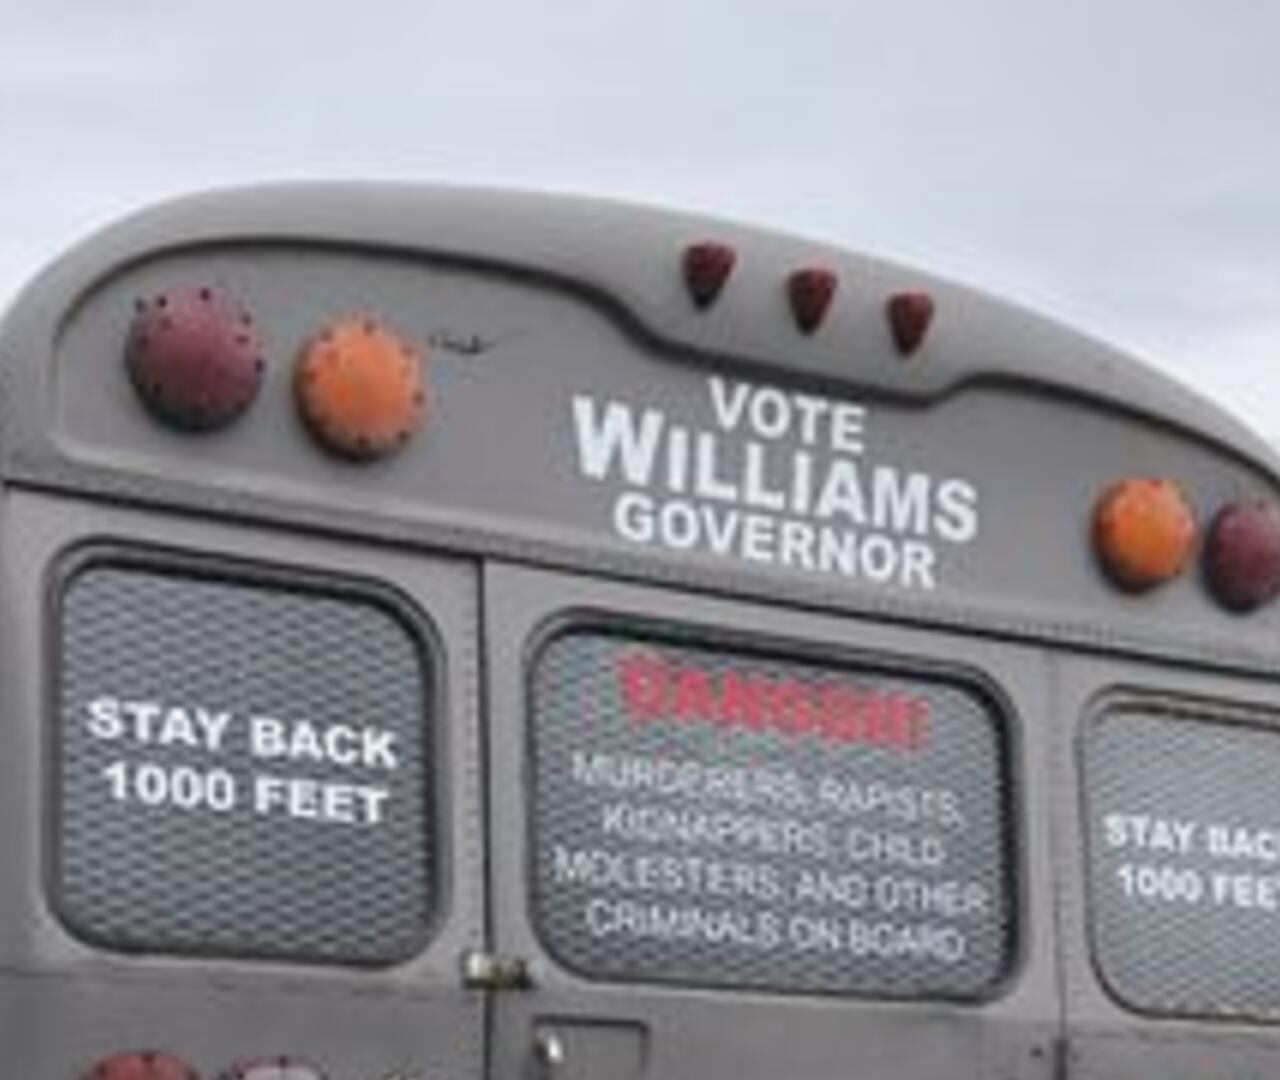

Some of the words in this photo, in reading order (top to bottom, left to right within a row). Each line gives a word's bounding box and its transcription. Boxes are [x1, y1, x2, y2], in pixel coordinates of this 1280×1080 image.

[707, 375, 867, 453] VOTE
[572, 395, 978, 543] WILLIAMS
[614, 493, 936, 588] GOVERNOR
[87, 697, 231, 752] STAY
[250, 716, 397, 769] BACK
[103, 761, 235, 812] 1000
[254, 775, 389, 823] FEET
[848, 830, 945, 867] CHILD
[1102, 815, 1198, 852] STAY
[794, 869, 867, 907] AND
[873, 873, 992, 916] OTHER
[1117, 864, 1202, 902] 1000
[585, 898, 781, 946] CRIMINALS
[788, 914, 841, 952] ON
